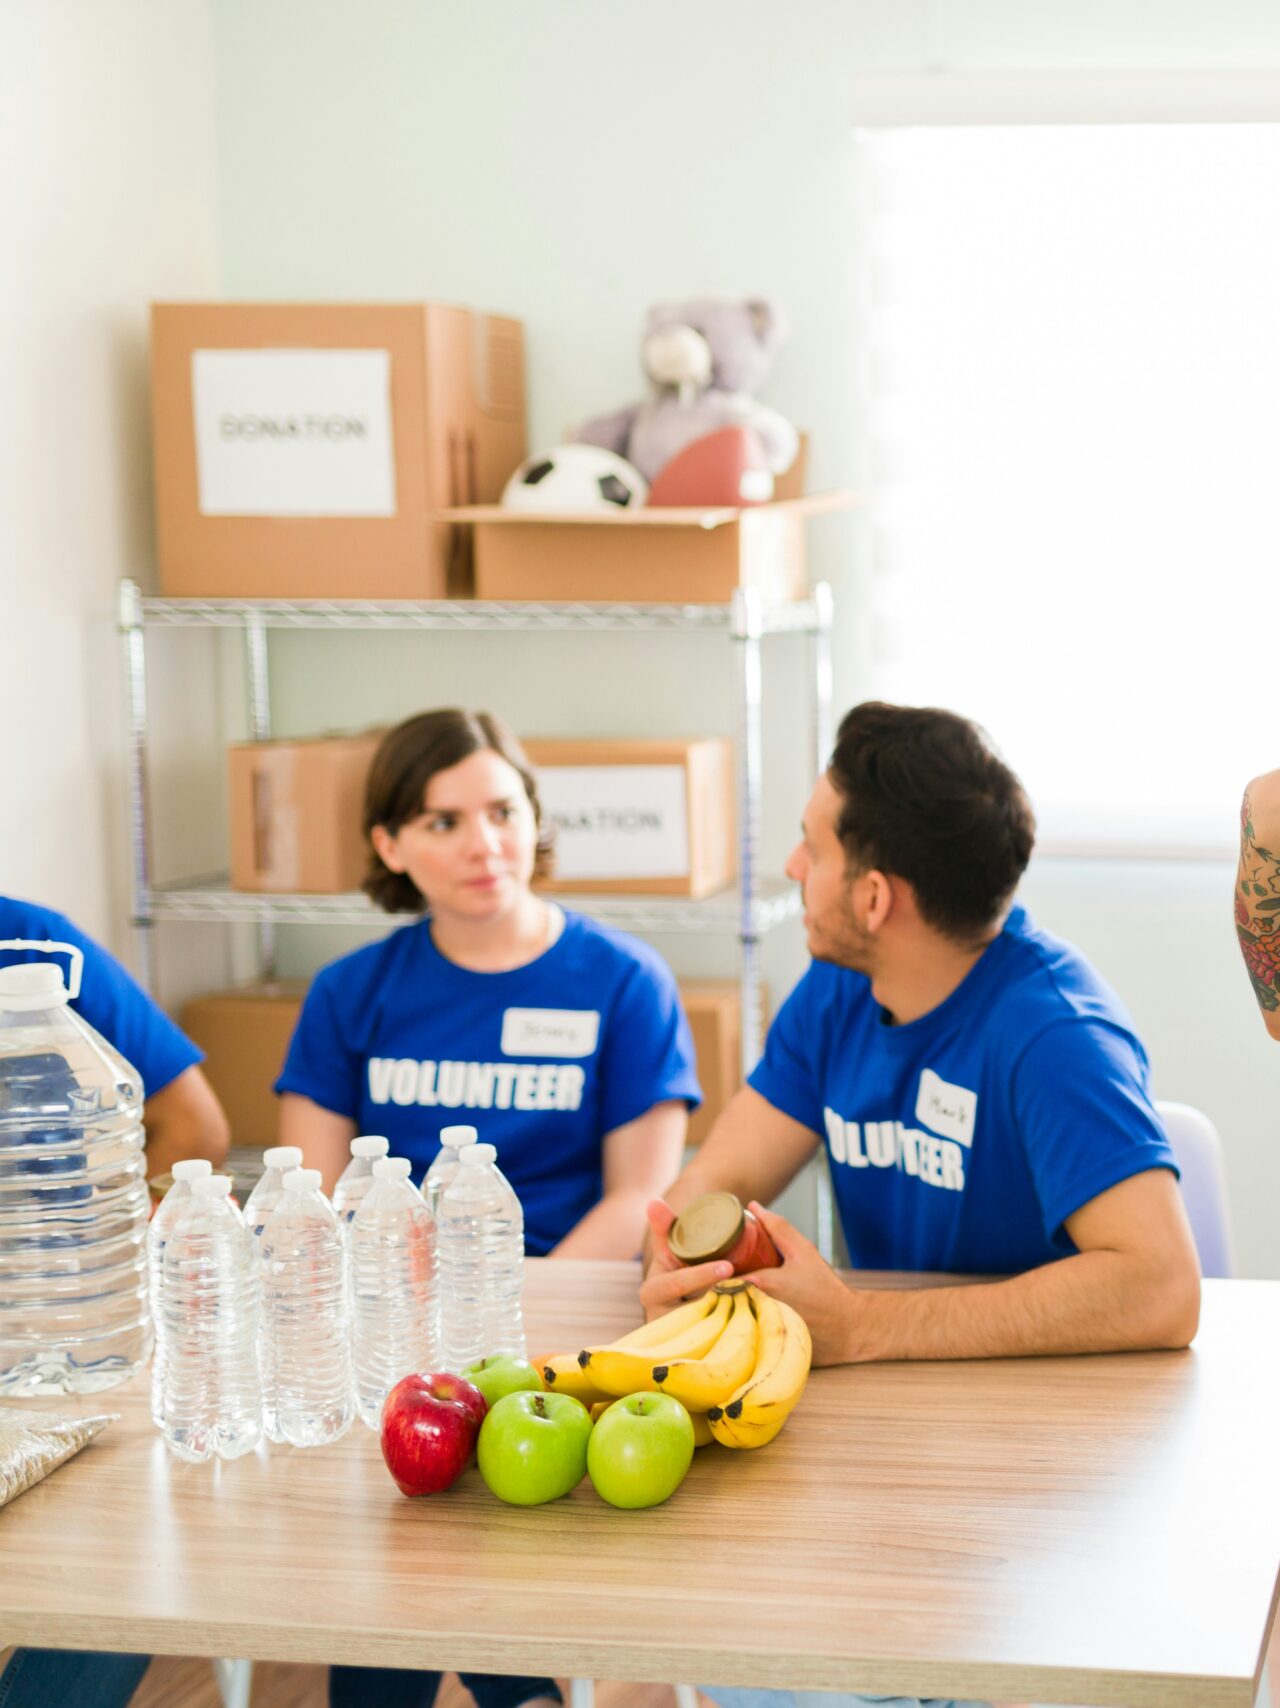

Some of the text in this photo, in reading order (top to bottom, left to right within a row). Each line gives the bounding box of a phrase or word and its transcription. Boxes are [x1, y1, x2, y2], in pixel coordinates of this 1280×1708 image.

[219, 413, 369, 443] DONATION
[546, 807, 662, 834] NATION
[368, 1057, 586, 1111] VOLUNTEER
[824, 1106, 964, 1191] OLUTEER
